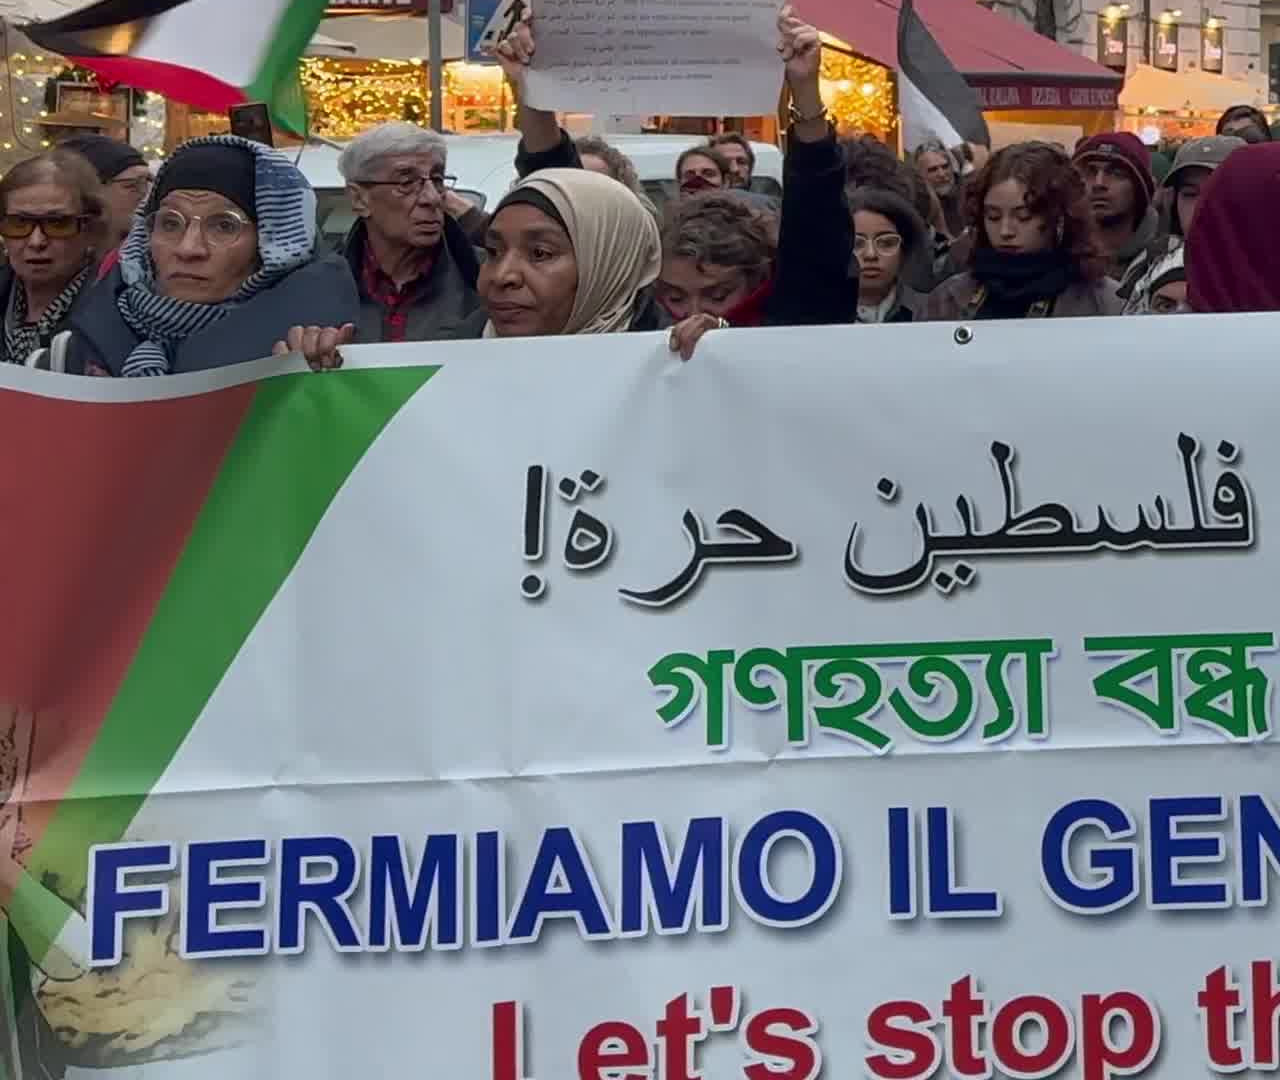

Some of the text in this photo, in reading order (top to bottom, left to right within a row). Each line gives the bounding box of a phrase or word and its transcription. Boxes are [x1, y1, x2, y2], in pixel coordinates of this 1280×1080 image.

[844, 432, 1252, 597] فلسطين
[648, 635, 1051, 754] গণহত্যা
[1084, 629, 1275, 740] বন্ধ
[90, 806, 840, 962] FERMIAMO
[888, 805, 998, 917] IL
[491, 984, 818, 1080] Let's
[865, 974, 1156, 1080] stop
